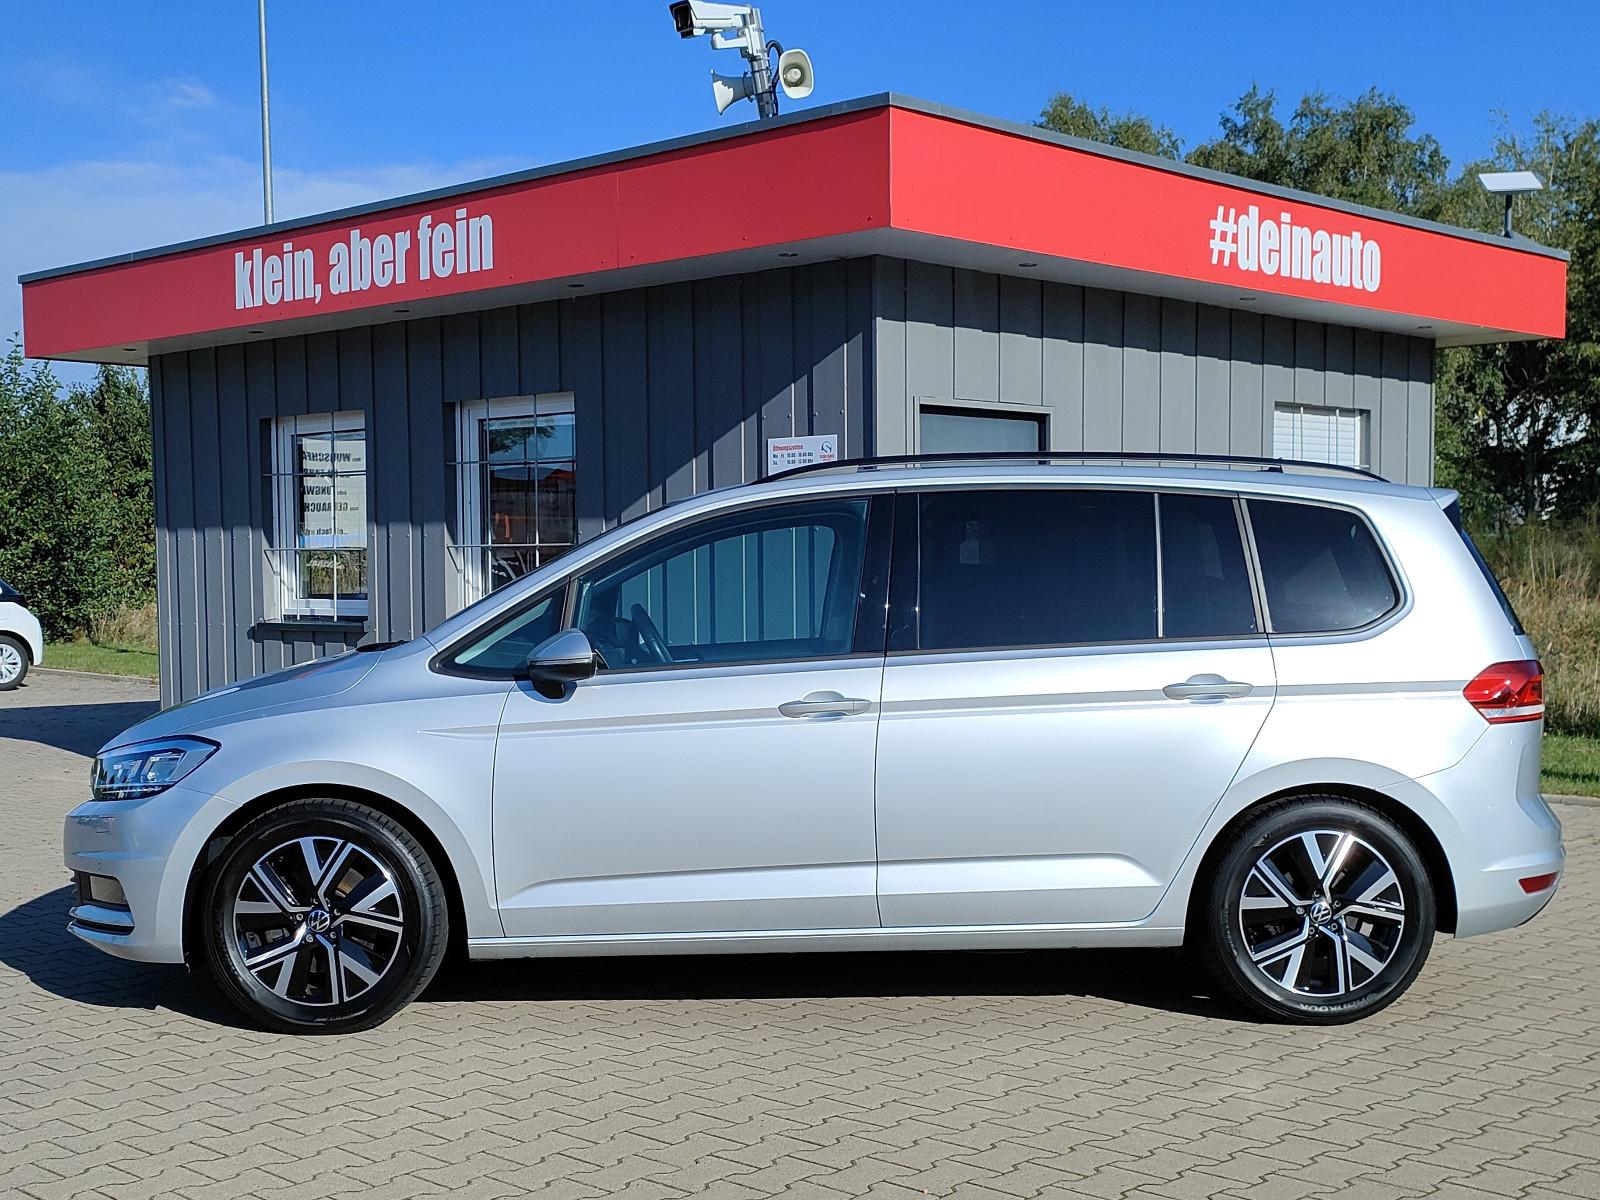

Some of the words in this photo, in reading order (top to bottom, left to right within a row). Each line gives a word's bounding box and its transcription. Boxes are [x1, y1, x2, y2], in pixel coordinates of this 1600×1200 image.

[235, 242, 322, 310] klein,
[328, 229, 410, 295] aber
[417, 208, 494, 281] fein
[1209, 205, 1381, 292] #deinauto
